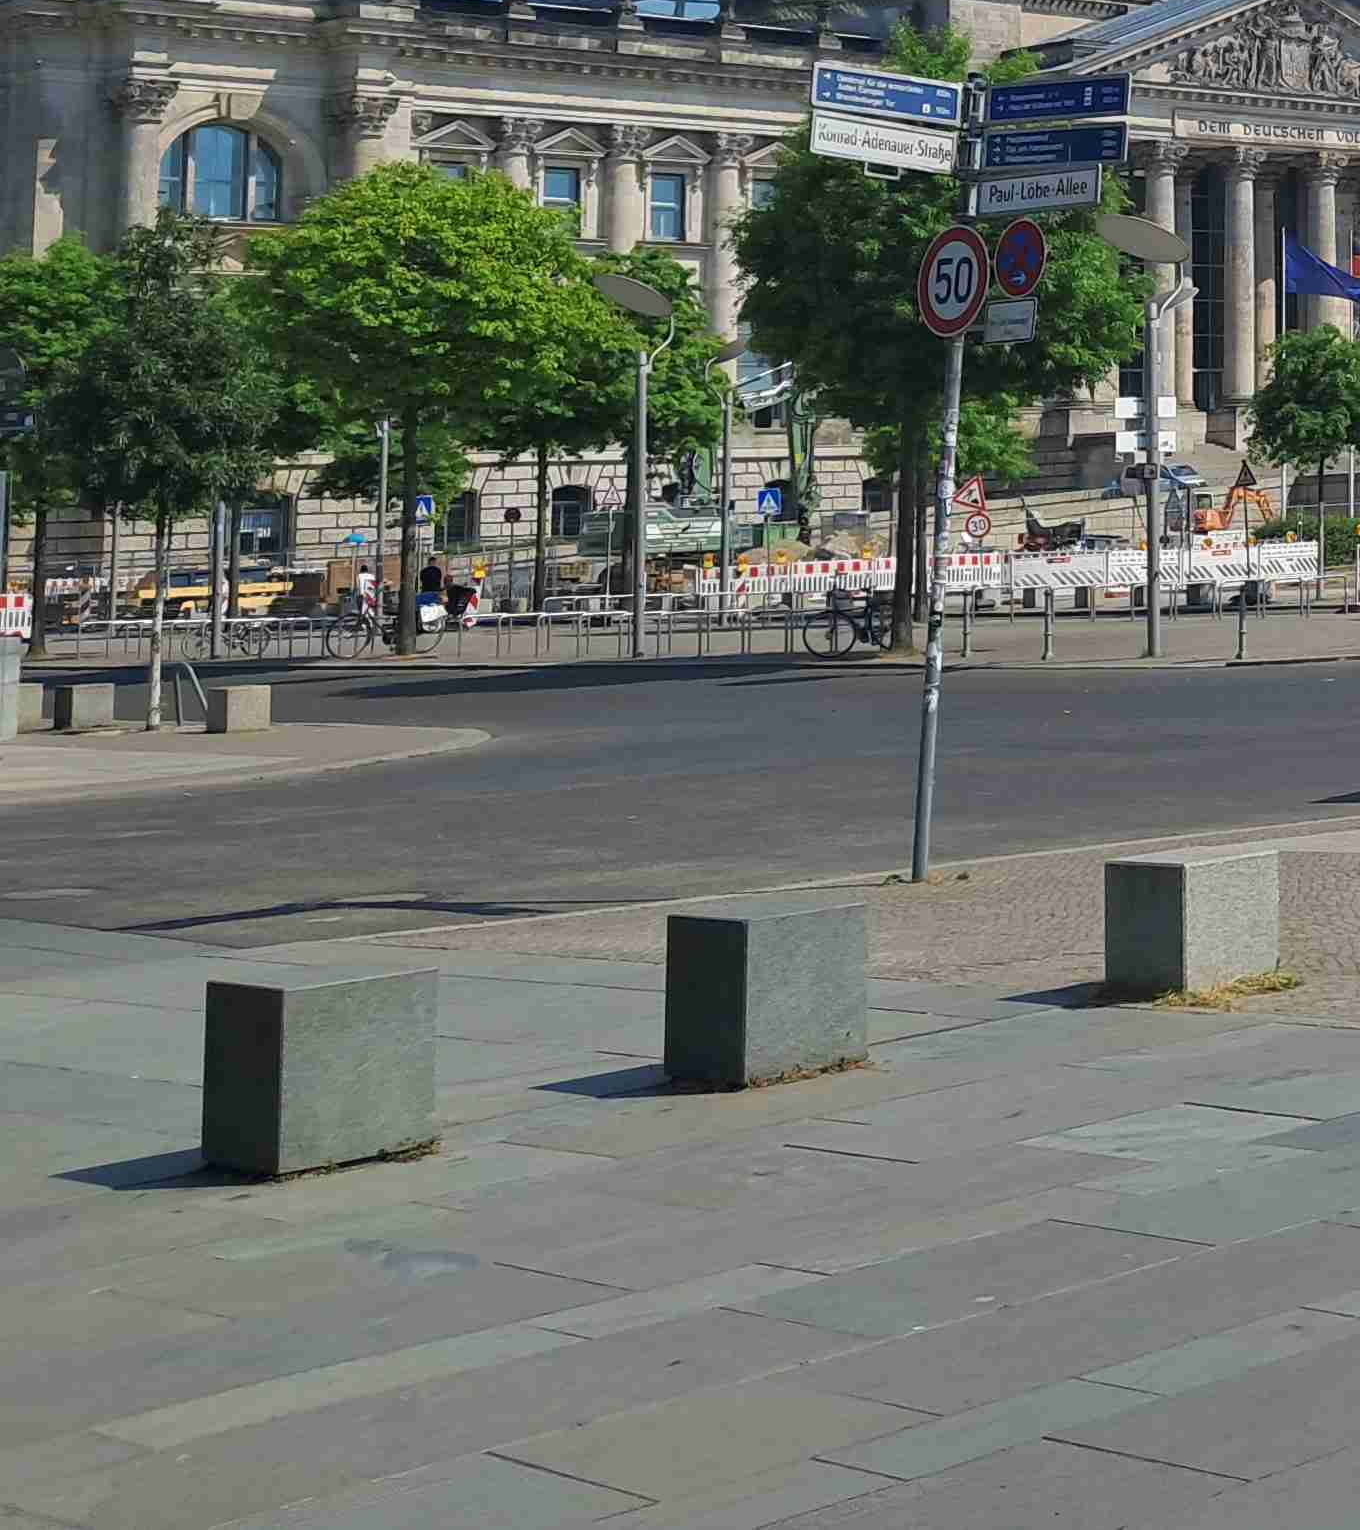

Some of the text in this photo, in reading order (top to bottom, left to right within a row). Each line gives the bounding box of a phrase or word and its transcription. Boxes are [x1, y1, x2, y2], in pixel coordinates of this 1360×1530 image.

[819, 123, 952, 163] Konrad-Adenauer-Straße
[1199, 120, 1231, 134] DEM
[1243, 123, 1324, 141] DEUTSCHEN
[989, 176, 1088, 203] Paul-Löhe-Allee
[934, 257, 974, 305] 50
[970, 518, 987, 532] 30
